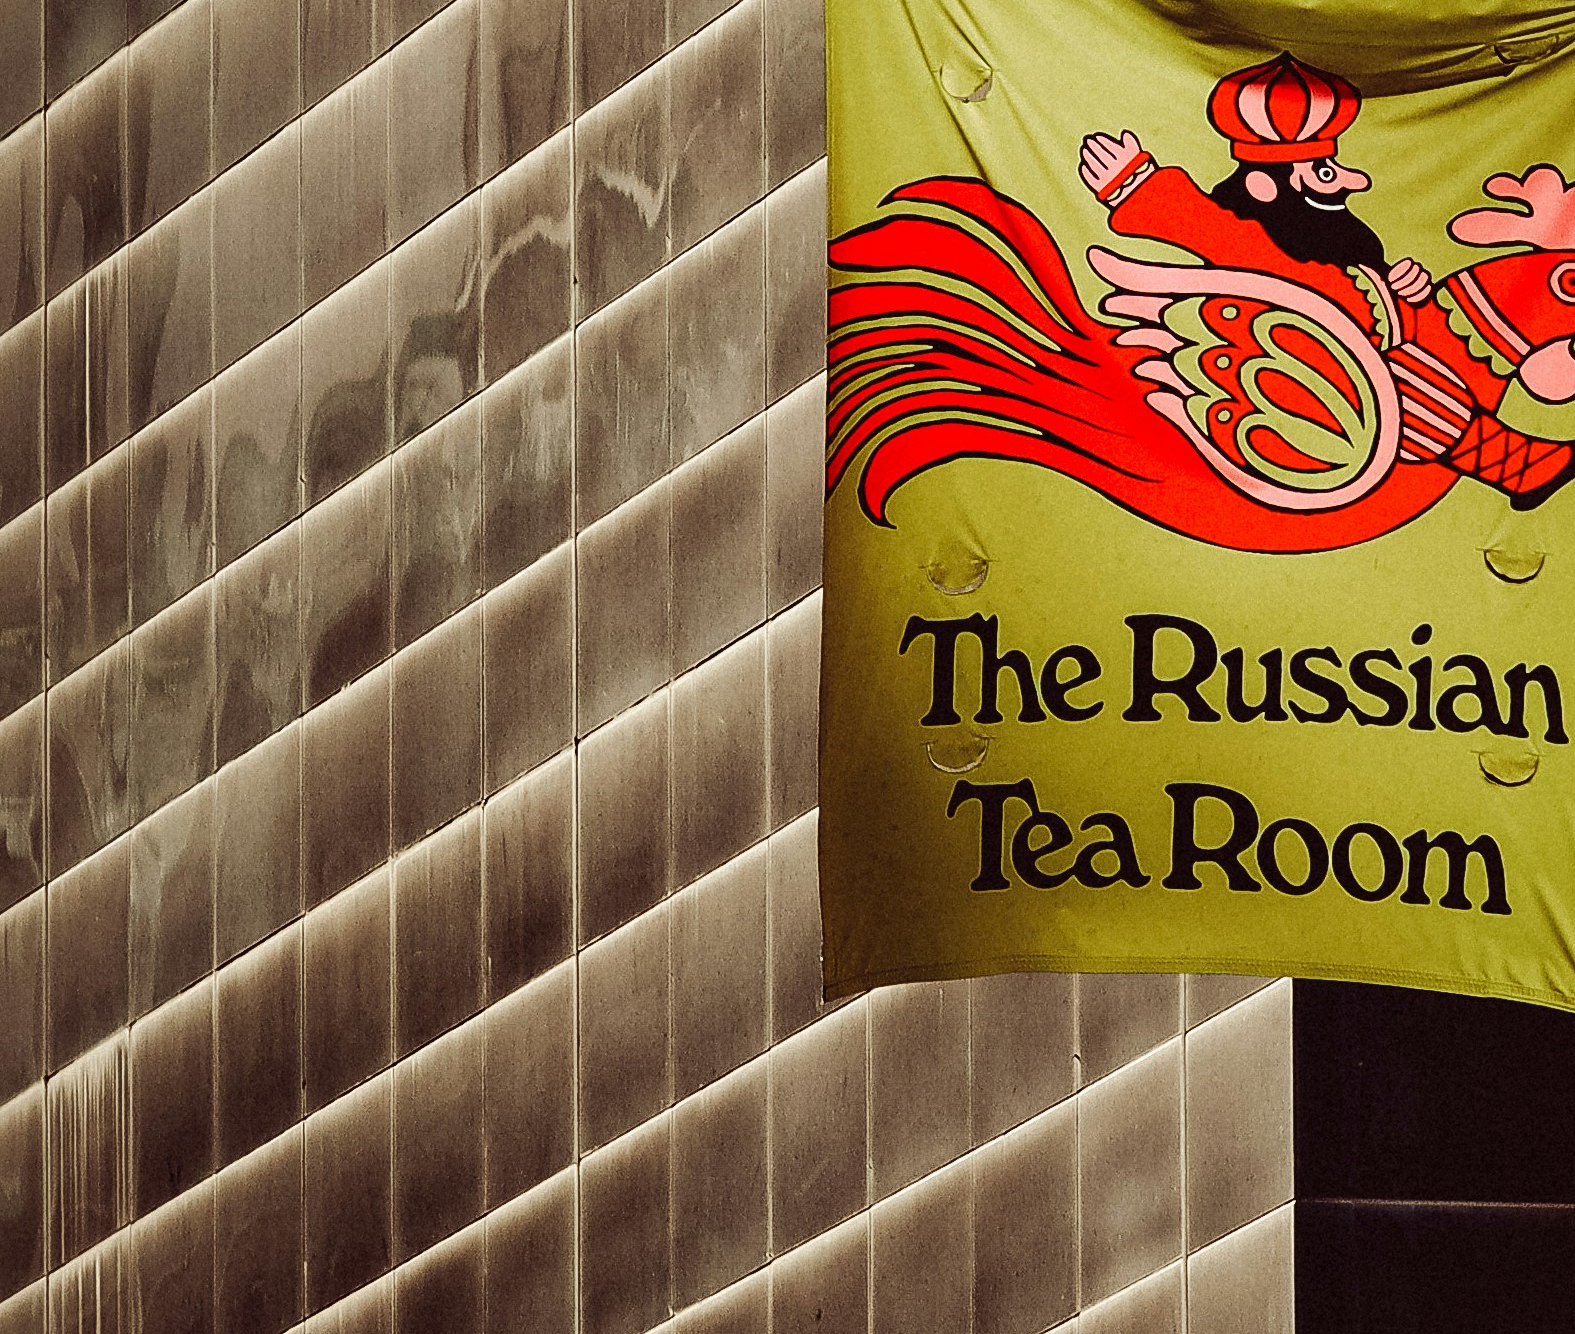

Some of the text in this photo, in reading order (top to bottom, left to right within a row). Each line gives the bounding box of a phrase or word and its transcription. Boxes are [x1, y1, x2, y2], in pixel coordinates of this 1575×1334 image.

[899, 613, 1570, 744] The Russian
[946, 778, 1512, 915] Tea Room
